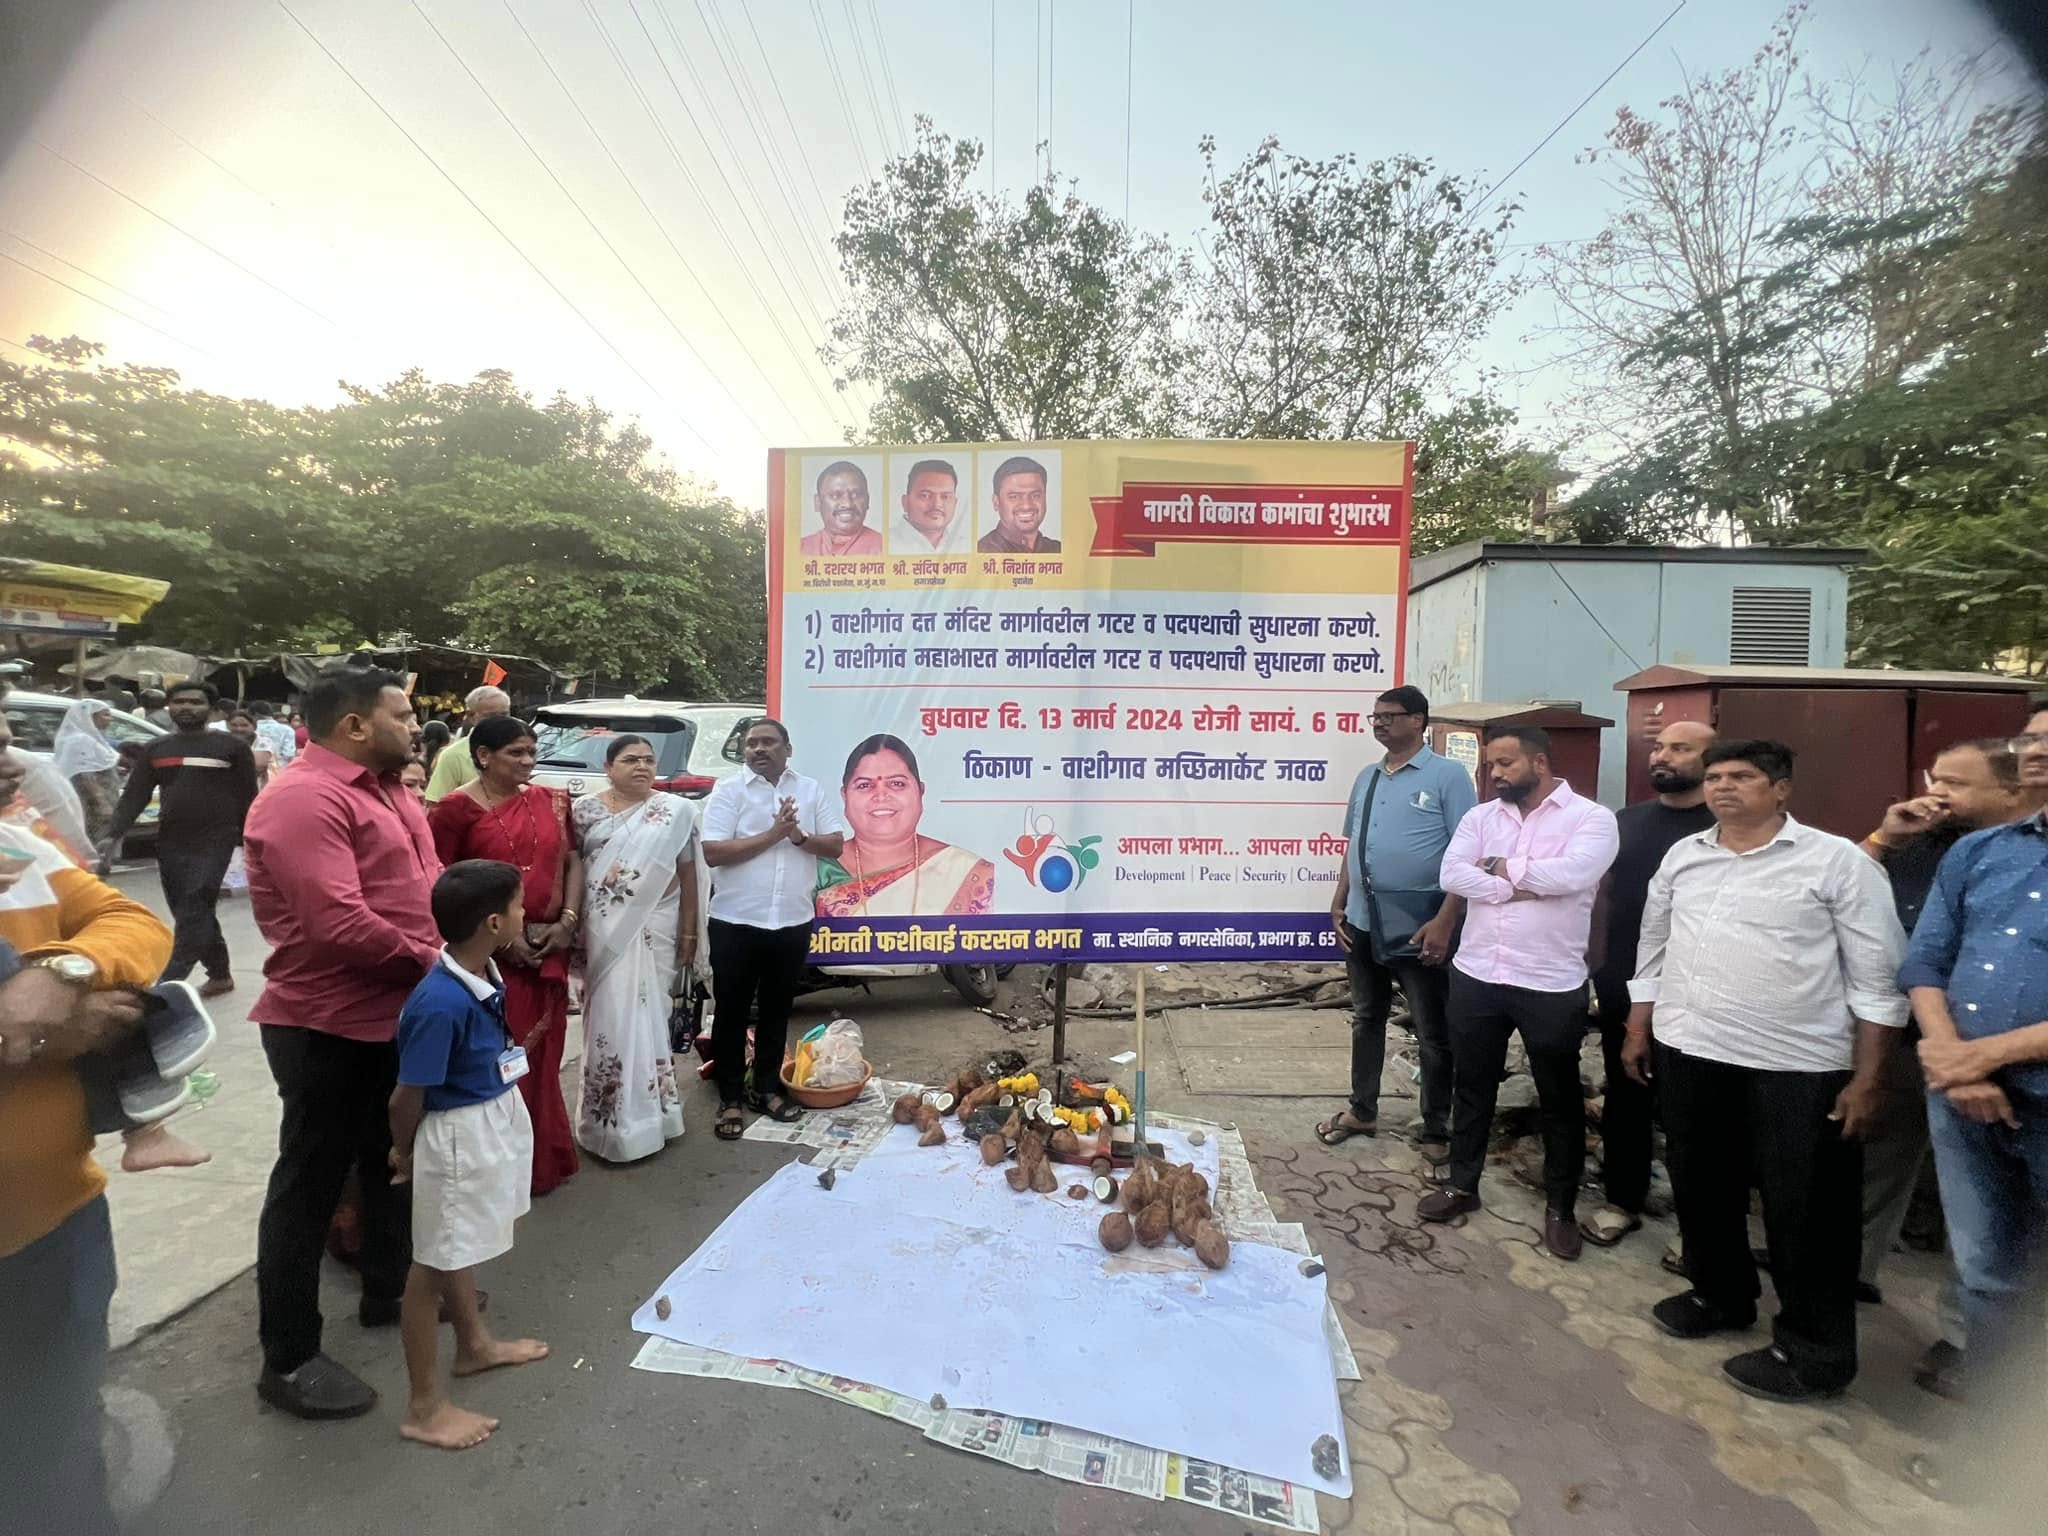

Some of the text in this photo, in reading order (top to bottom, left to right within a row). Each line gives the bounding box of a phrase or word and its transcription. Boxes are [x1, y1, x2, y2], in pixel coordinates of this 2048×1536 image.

[1144, 493, 1391, 535] नागरी विकास कामांचा शुभारंभ
[805, 560, 885, 576] श्री. दशरथ भगत
[893, 560, 968, 576] श्री. संदिप भगत
[984, 558, 1063, 575] श्री. निशांत भगत
[805, 606, 1380, 643] 1) वाशीगांव दत्त मंदिर मार्गावरील गटर व पदपथाची सुधारना करणे.
[805, 642, 1385, 679] 2) वाशीगांव महाभारत मार्गावरील गटर व पदपथाची सुधारना करणे.
[920, 702, 1364, 736] बुधवार दि. 13 मार्च 2024 रोजी सायं. 6 वा.
[963, 750, 1033, 779] ठिकाण
[1061, 750, 1147, 779] वाशीगाव
[1155, 751, 1267, 781] मच्छिमार्केट
[1275, 759, 1328, 781] जवळ
[1117, 832, 1349, 856] आपला प्रभाग... आपला परिव
[1115, 867, 1185, 884] Development
[1200, 867, 1231, 882] Peace
[1242, 867, 1288, 884] Security
[809, 924, 1083, 954] श्रीमती फशीबाई करसन भगत
[1092, 927, 1336, 949] मा. स्थानिक नगरसेविका, प्रभाग क्र. 65
